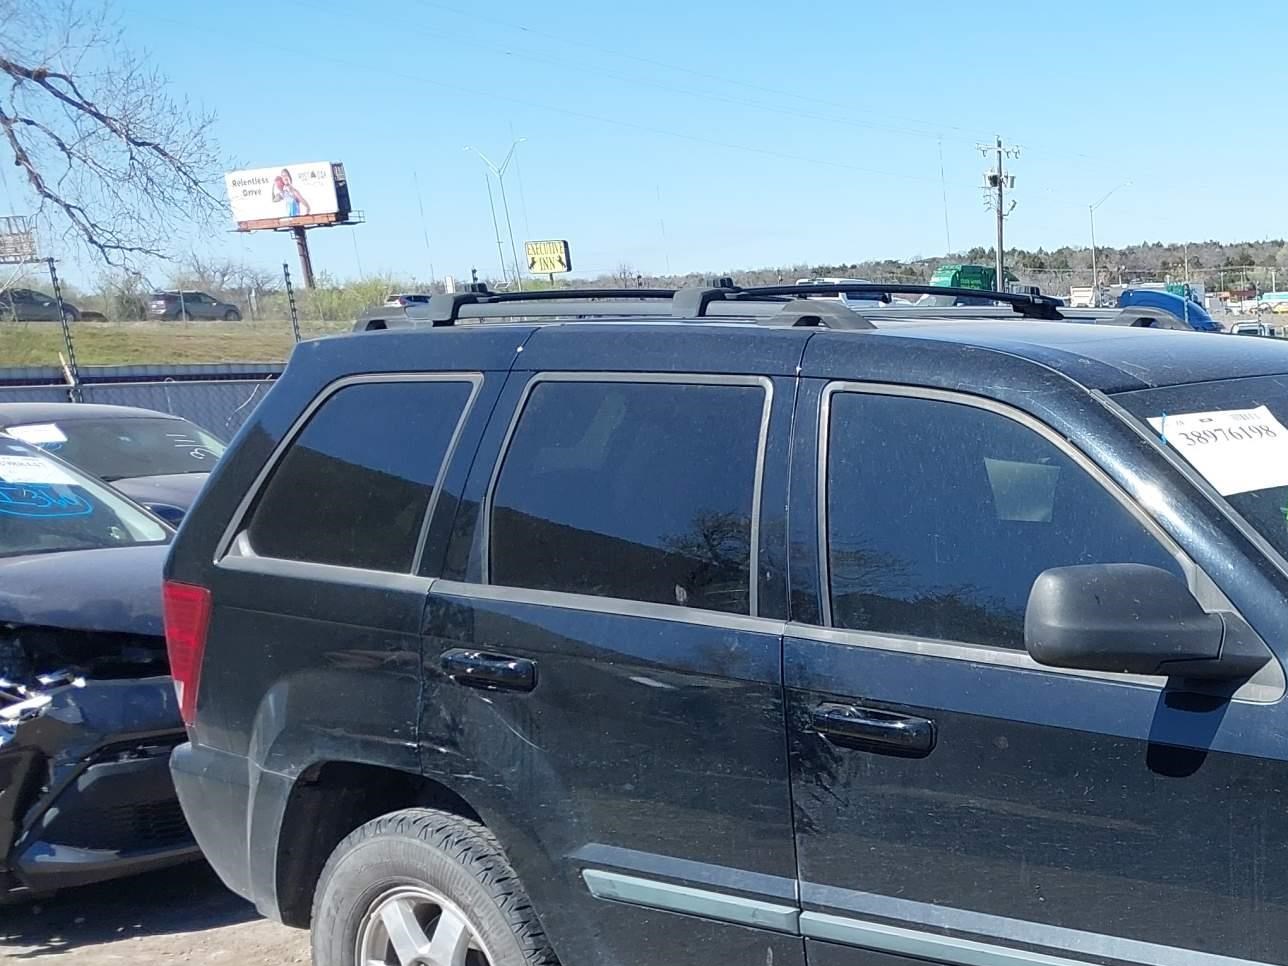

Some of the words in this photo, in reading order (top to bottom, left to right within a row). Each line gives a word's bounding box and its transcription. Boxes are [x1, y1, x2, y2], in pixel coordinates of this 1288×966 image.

[527, 242, 564, 256] EXECUTIVE
[539, 256, 556, 271] INN
[1178, 423, 1278, 447] 38976198
